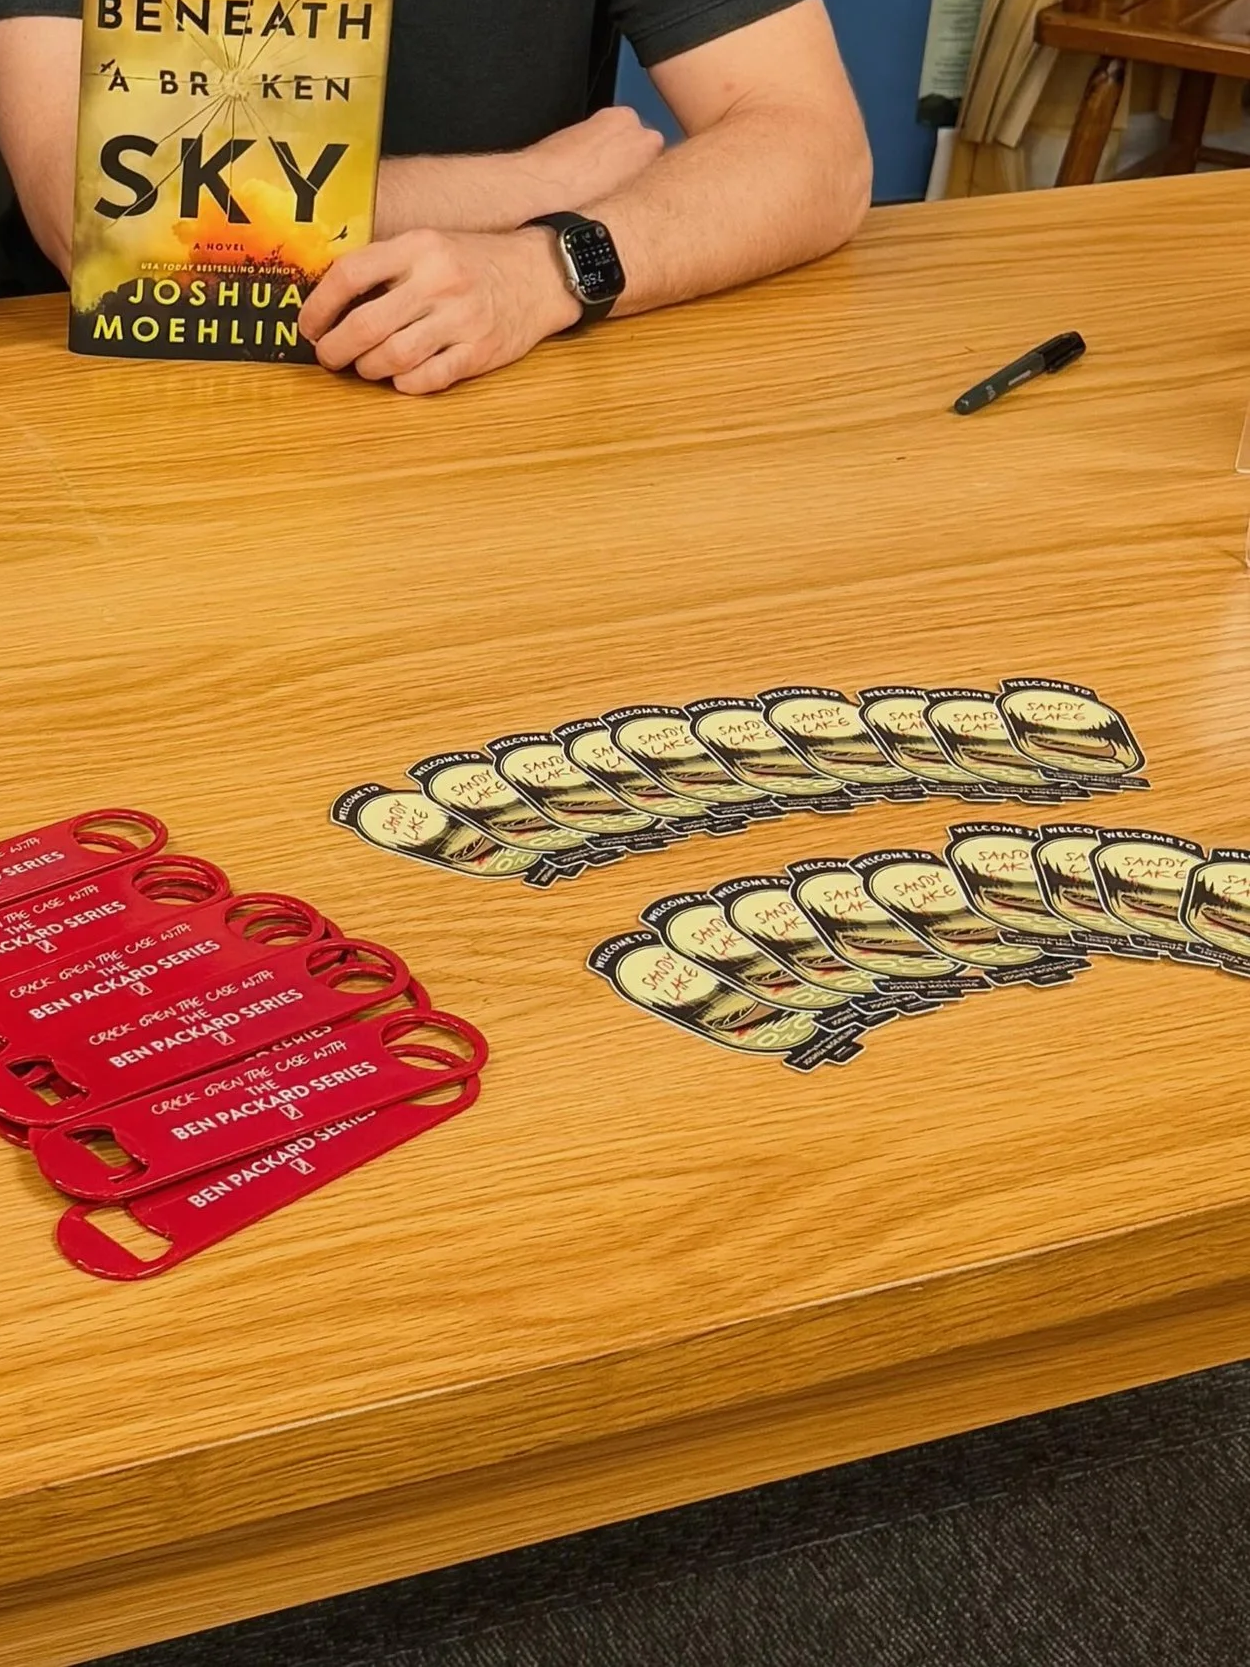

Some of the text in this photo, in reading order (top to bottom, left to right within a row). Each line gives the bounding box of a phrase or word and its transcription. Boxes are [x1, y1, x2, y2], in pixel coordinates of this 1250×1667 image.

[108, 67, 130, 92] A
[94, 134, 350, 224] SKY
[193, 242, 245, 252] A NOVEL
[141, 262, 297, 275] USA TODAY BESTSELLING AUTHOR
[128, 278, 302, 309] JOSHUA
[93, 314, 299, 346] MOEHLIN
[1006, 680, 1092, 696] WELCOME TO
[1026, 701, 1085, 712] SANDY
[1031, 712, 1086, 721] LAKE
[10, 835, 41, 854] WITH
[1103, 831, 1196, 850] WELCOME TO
[1, 849, 65, 878] SERIES
[1122, 857, 1188, 868] SANDY
[1128, 868, 1186, 879] LAKE
[595, 933, 652, 969] WELCOME TO
[642, 952, 677, 990] SANDY
[664, 965, 698, 1000] LAKE
[151, 1040, 348, 1116] CRACK OPEN THE CASE WITH
[244, 1079, 280, 1098] THE
[171, 1060, 378, 1141] BEN PACKARD SERIES
